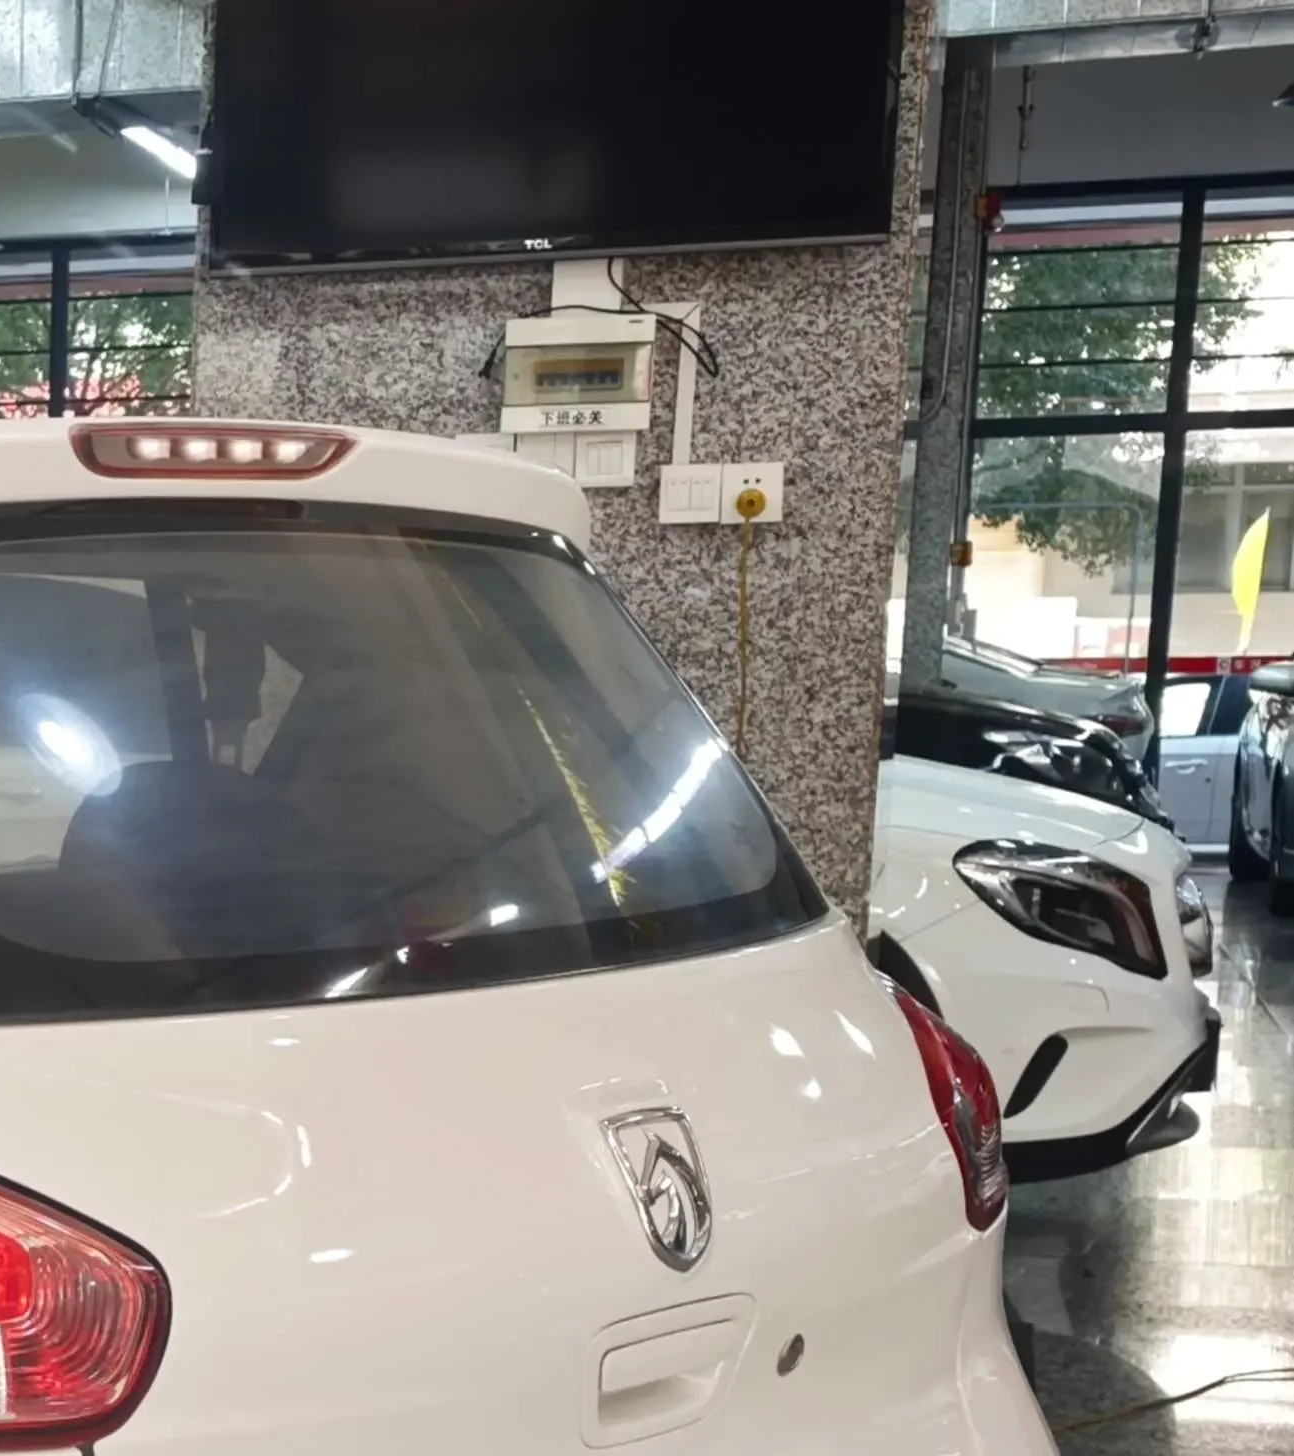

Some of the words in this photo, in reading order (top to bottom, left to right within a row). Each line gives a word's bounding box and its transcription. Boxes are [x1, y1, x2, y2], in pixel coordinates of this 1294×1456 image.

[524, 239, 552, 250] TCL
[542, 410, 603, 426] 下班必关
